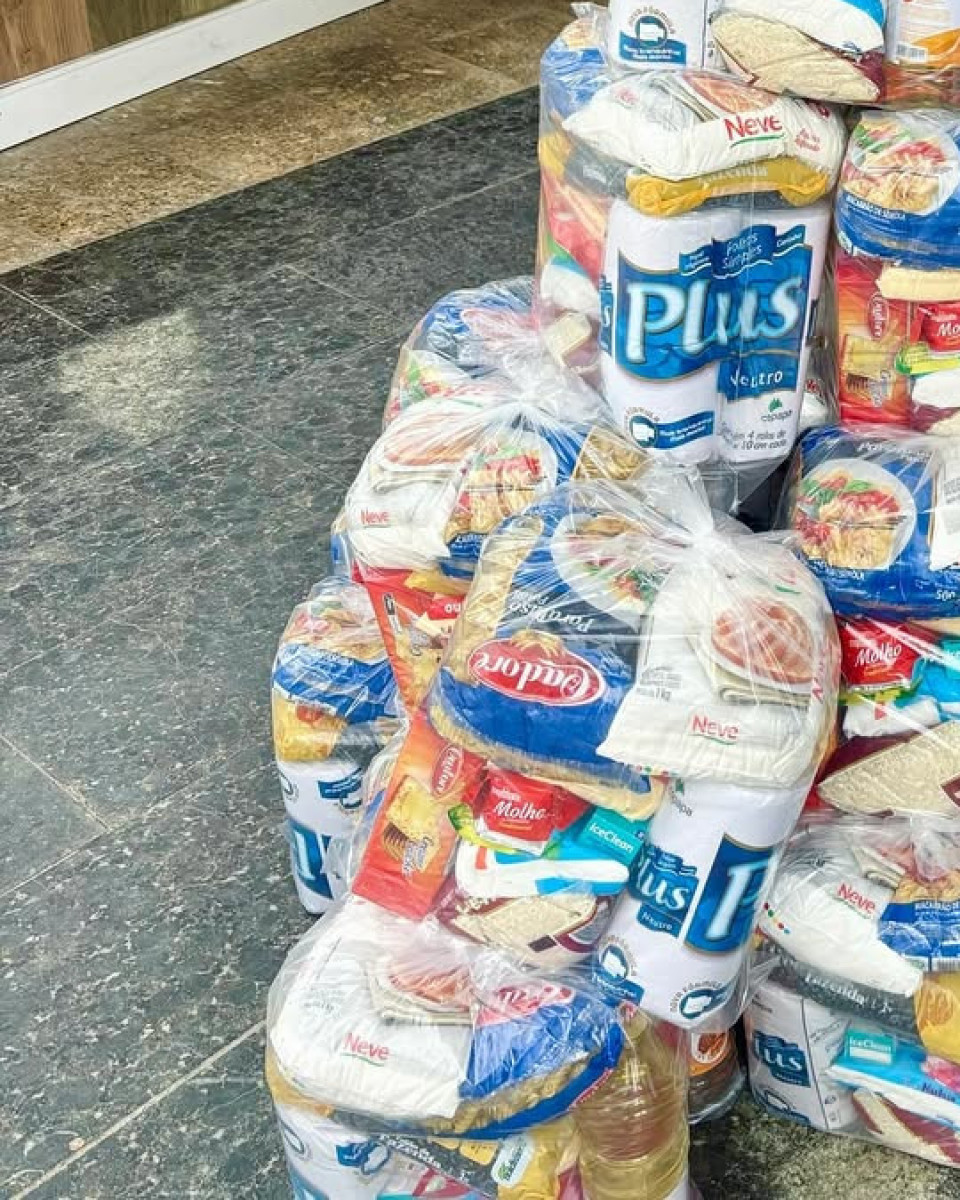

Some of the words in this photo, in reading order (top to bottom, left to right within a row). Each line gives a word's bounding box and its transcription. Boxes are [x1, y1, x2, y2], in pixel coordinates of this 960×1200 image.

[724, 114, 783, 141] Neve
[625, 276, 801, 364] Plus
[854, 643, 903, 667] Molho
[472, 647, 592, 702] Cadore
[690, 713, 738, 741] Neve
[493, 800, 546, 821] Molho
[588, 821, 634, 853] IceClean
[836, 882, 877, 915] Neve
[341, 1031, 391, 1061] Neve
